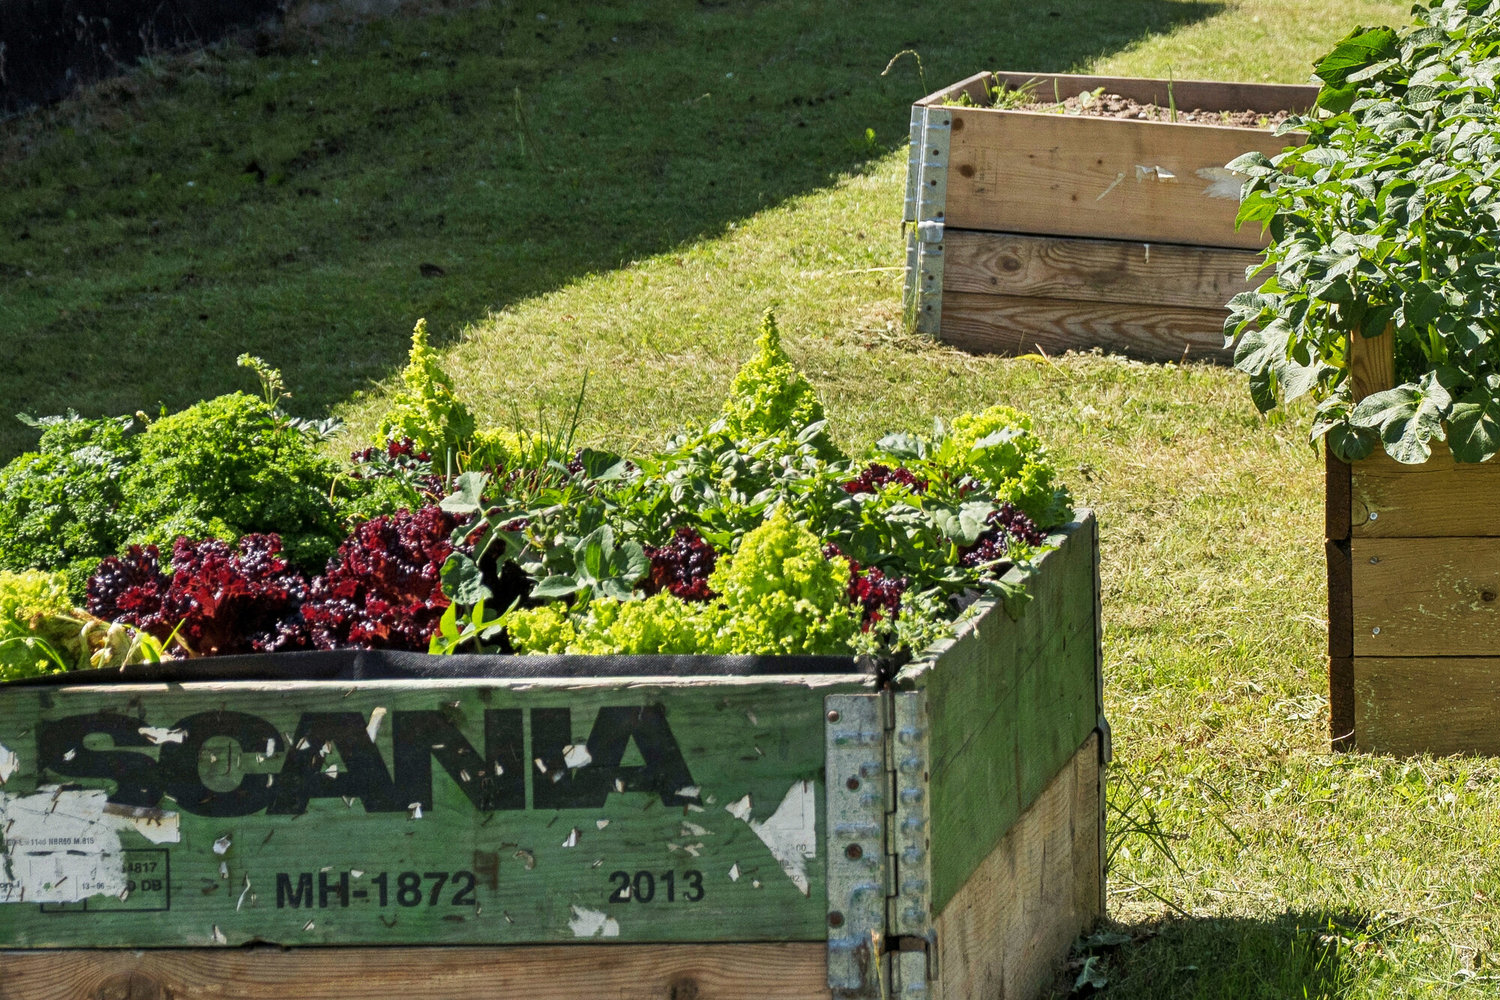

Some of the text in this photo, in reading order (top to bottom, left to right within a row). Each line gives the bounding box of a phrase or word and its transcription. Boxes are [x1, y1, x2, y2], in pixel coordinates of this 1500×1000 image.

[38, 704, 703, 817] SCANIA
[276, 870, 477, 909] MH-1872
[608, 869, 705, 904] 2013
